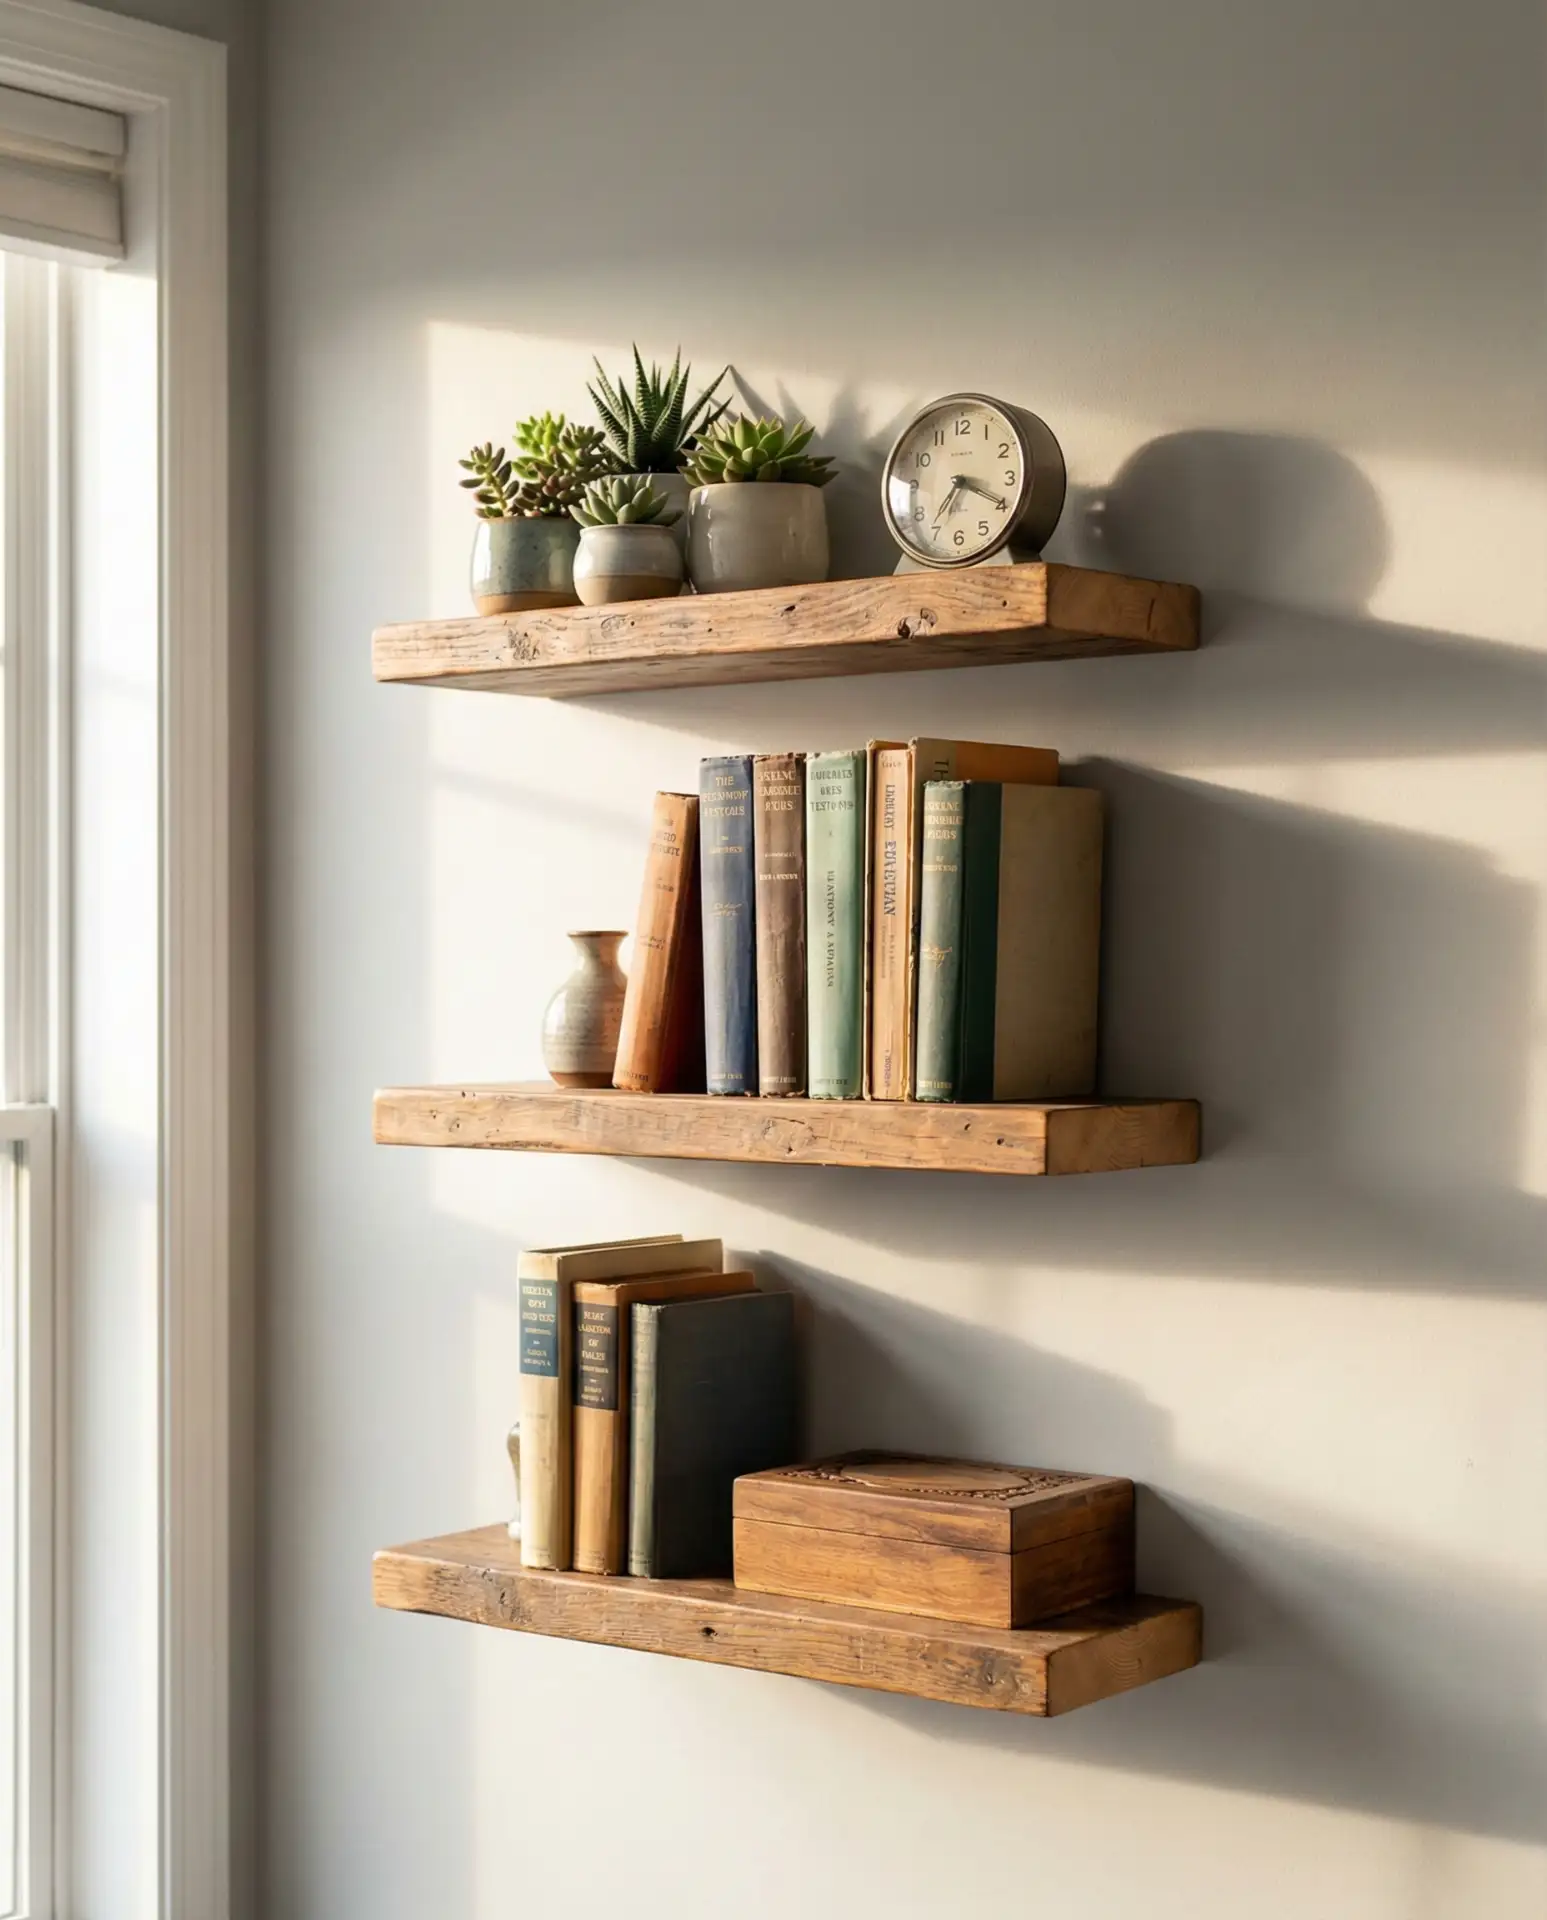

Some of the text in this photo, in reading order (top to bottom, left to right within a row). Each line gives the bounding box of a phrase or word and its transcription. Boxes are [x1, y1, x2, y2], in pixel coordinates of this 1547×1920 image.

[954, 419, 971, 436] 12
[984, 424, 988, 440] 1
[934, 430, 944, 446] 11
[997, 442, 1010, 458] 2
[915, 452, 931, 468] 10
[1004, 470, 1016, 486] 3
[995, 498, 1008, 512] 4
[914, 506, 925, 521] 8
[931, 526, 942, 541] 7
[978, 520, 990, 536] 5
[953, 530, 965, 545] 6
